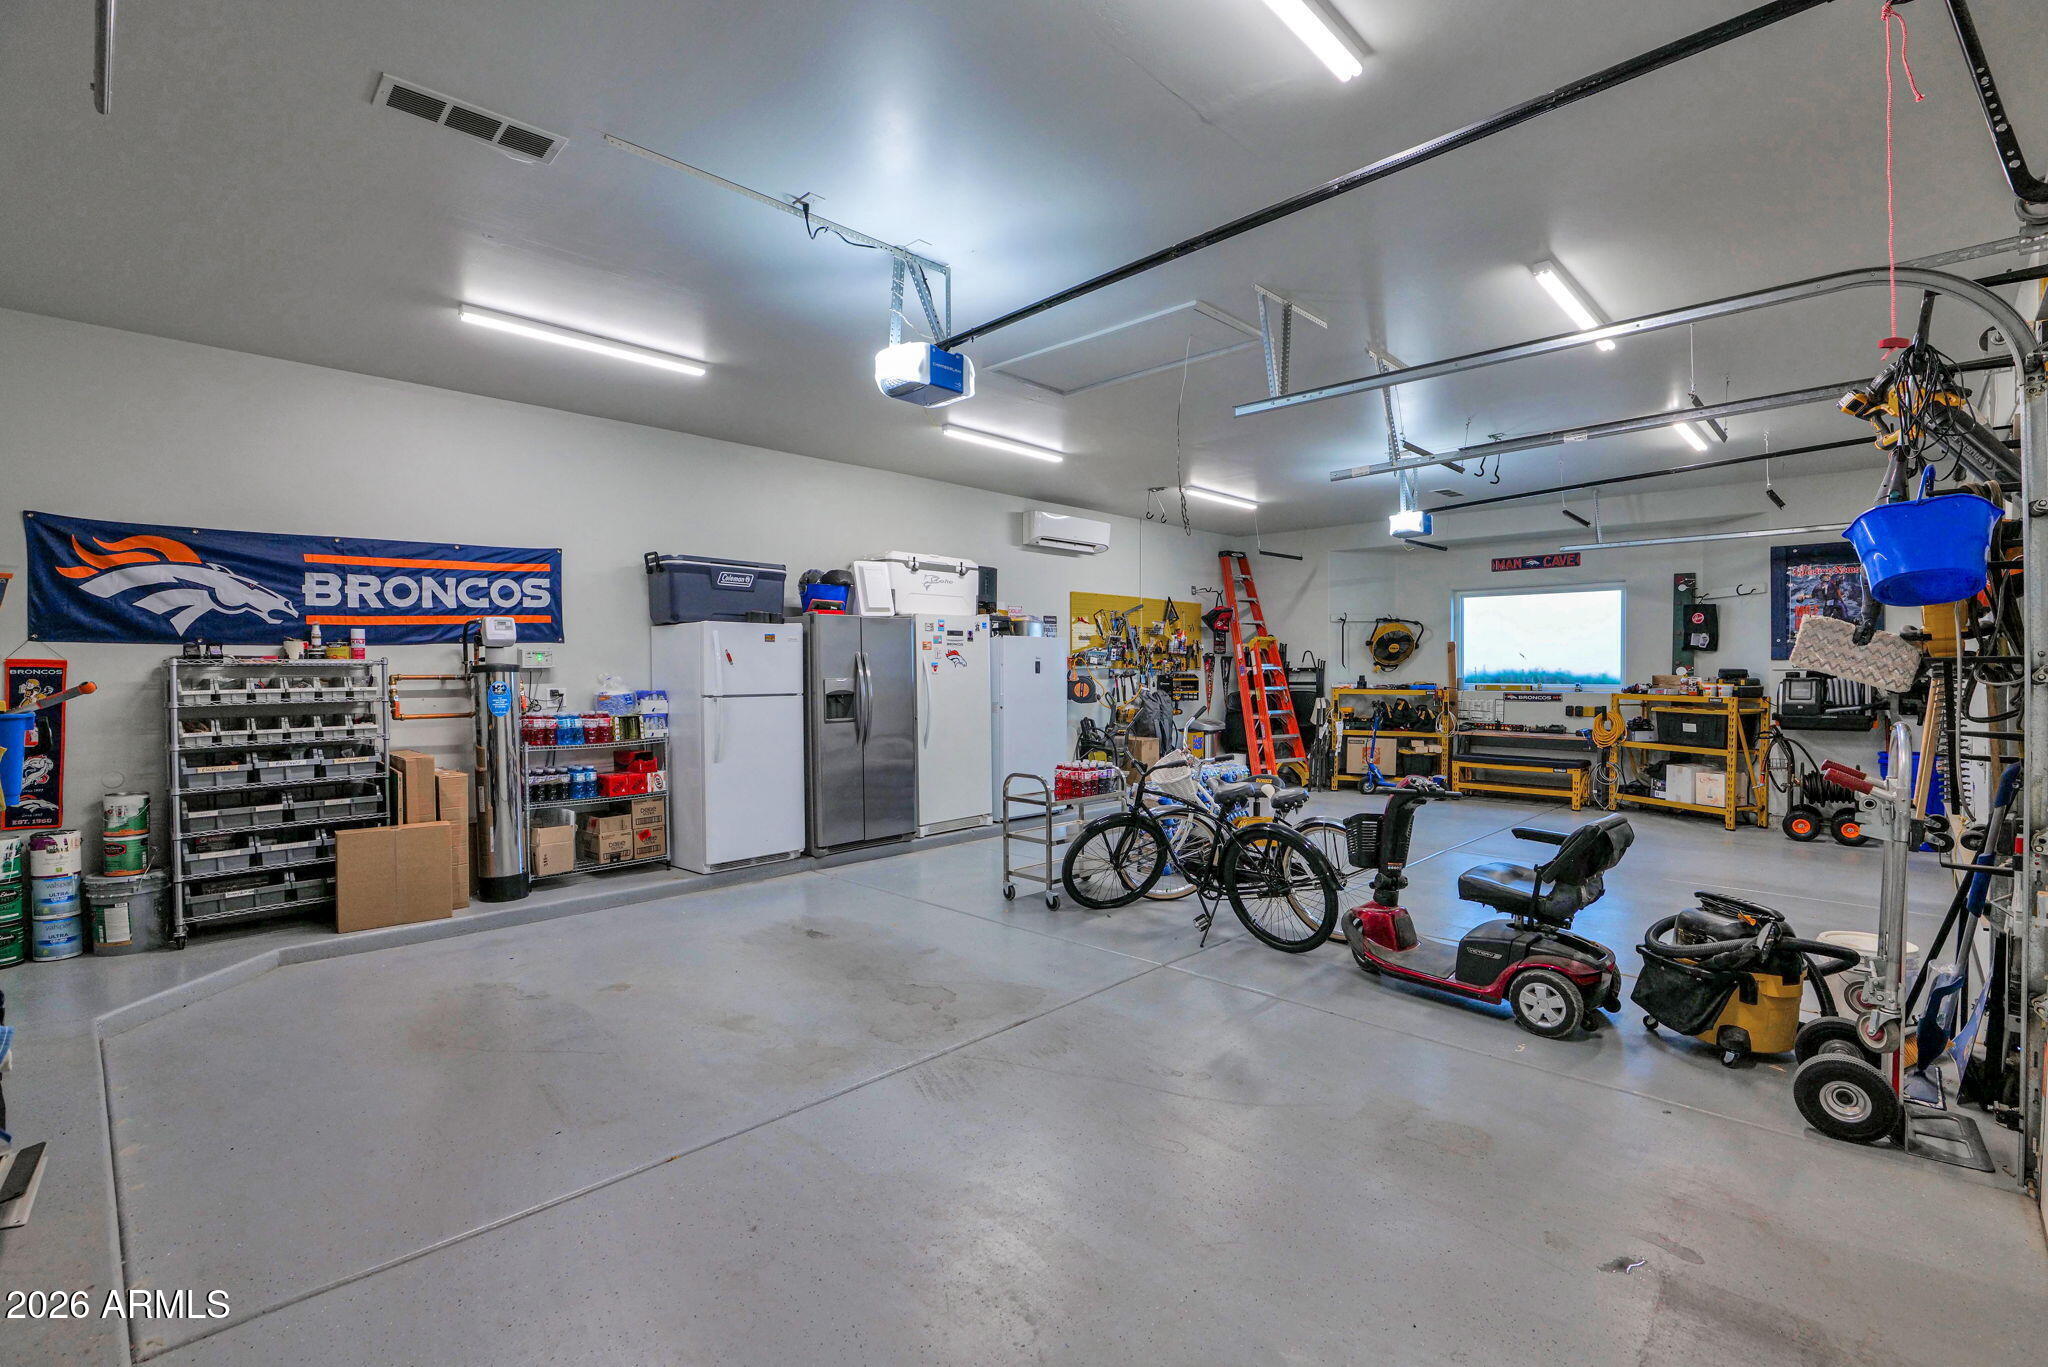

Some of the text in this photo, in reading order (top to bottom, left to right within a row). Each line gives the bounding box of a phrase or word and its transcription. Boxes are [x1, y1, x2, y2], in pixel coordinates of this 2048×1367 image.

[1495, 553, 1575, 570] MAN CAVE
[721, 573, 745, 583] Coleman
[302, 572, 551, 609] BRONCOS
[9, 668, 63, 676] BRONCOS
